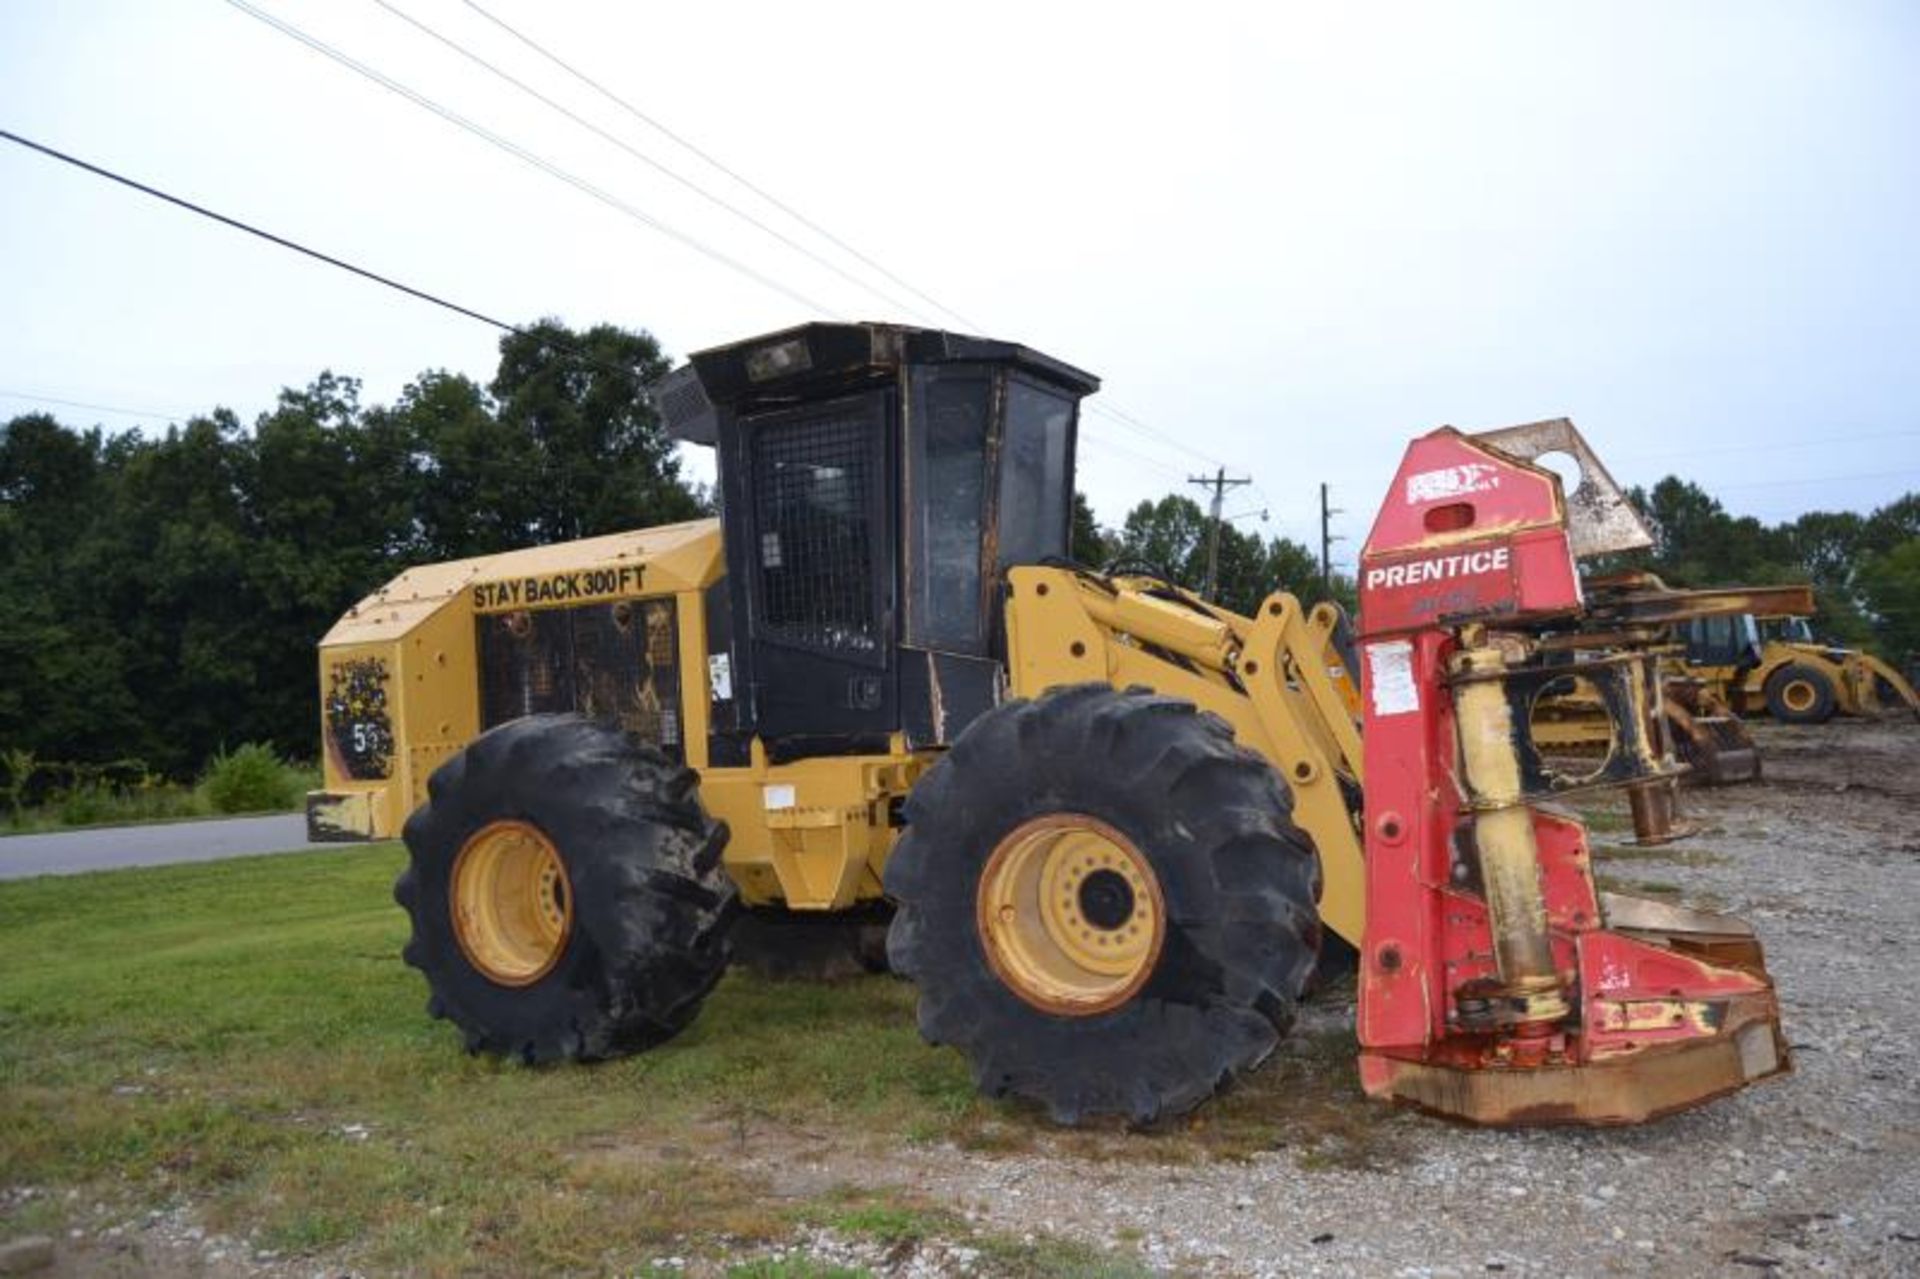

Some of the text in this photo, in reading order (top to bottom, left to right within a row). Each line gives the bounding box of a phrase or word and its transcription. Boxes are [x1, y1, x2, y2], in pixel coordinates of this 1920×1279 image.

[474, 563, 647, 608] STAY BACK 300 FT
[1367, 548, 1509, 590] PRENTICE
